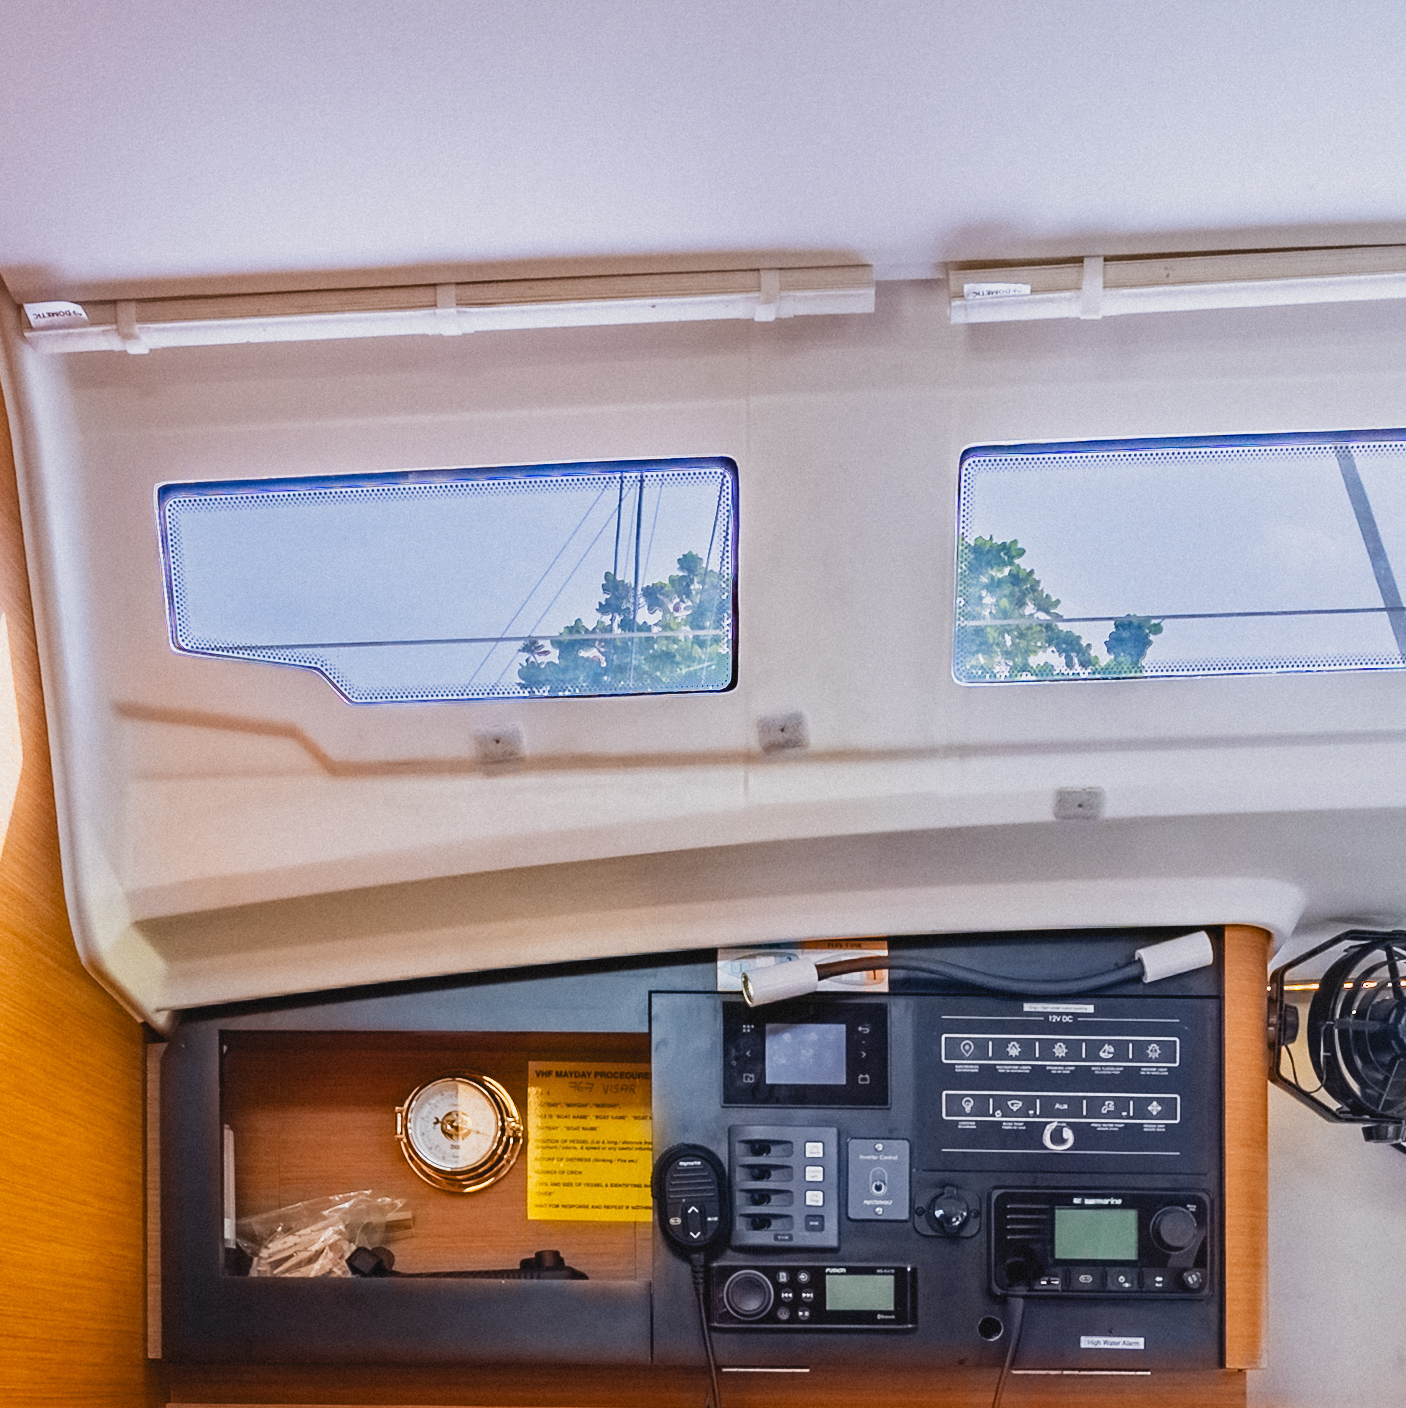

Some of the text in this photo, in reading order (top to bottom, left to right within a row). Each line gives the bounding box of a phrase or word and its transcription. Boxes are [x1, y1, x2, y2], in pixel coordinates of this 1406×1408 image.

[973, 288, 1011, 298] DOMETIC
[32, 310, 71, 319] DOMETIC
[1062, 1015, 1074, 1023] DC
[535, 1070, 652, 1079] VHF MAYDAY PROCEDURE
